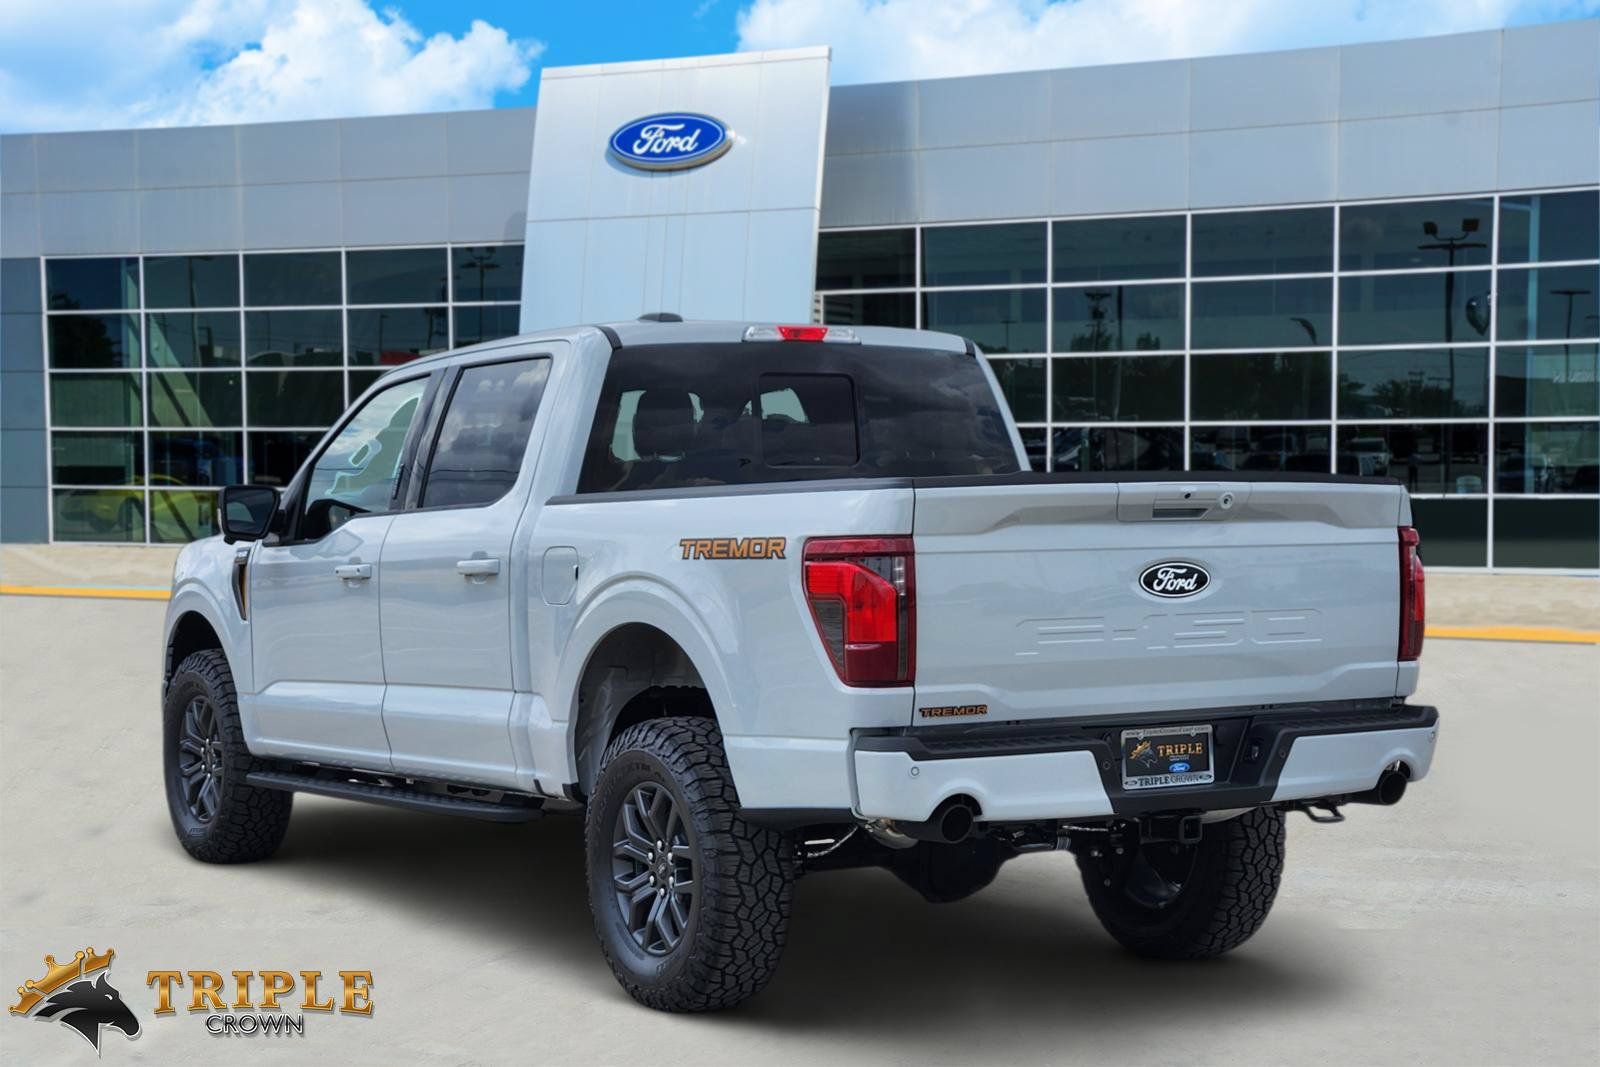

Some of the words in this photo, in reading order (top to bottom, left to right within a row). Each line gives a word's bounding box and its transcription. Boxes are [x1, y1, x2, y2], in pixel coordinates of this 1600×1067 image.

[632, 123, 701, 155] Ford
[680, 537, 786, 559] TREMOR
[1153, 567, 1198, 591] Ford
[919, 704, 987, 718] TREMOR
[1157, 743, 1203, 757] TRIPLE
[1138, 776, 1169, 786] TRIPLE
[1170, 774, 1199, 784] CROWN
